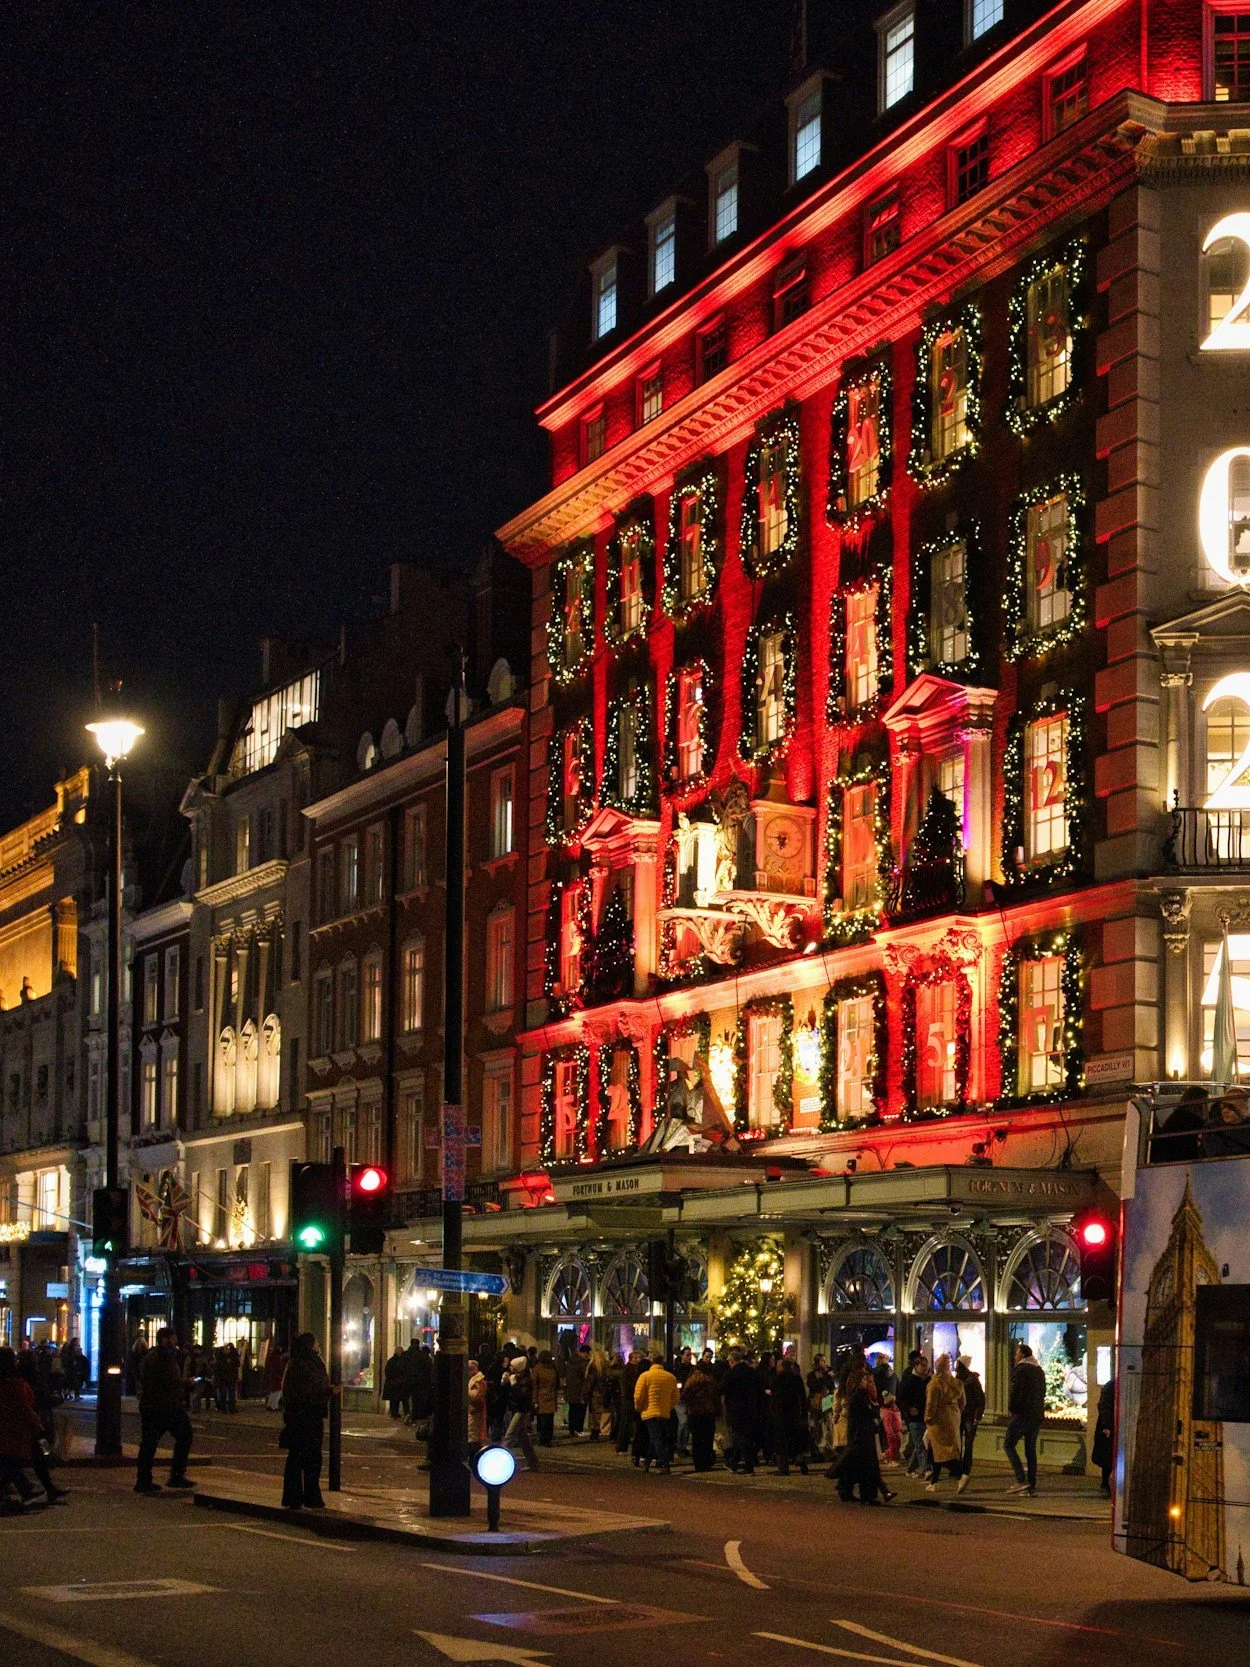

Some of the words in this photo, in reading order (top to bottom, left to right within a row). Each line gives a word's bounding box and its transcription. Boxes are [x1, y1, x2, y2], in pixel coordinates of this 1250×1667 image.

[846, 417, 880, 473] 20
[1029, 760, 1066, 812] 12
[926, 1022, 948, 1068] 5
[1022, 1004, 1056, 1054] 17
[1087, 1060, 1120, 1075] PICCADILLY
[572, 1182, 603, 1196] FORTNUM
[615, 1178, 640, 1191] MASON
